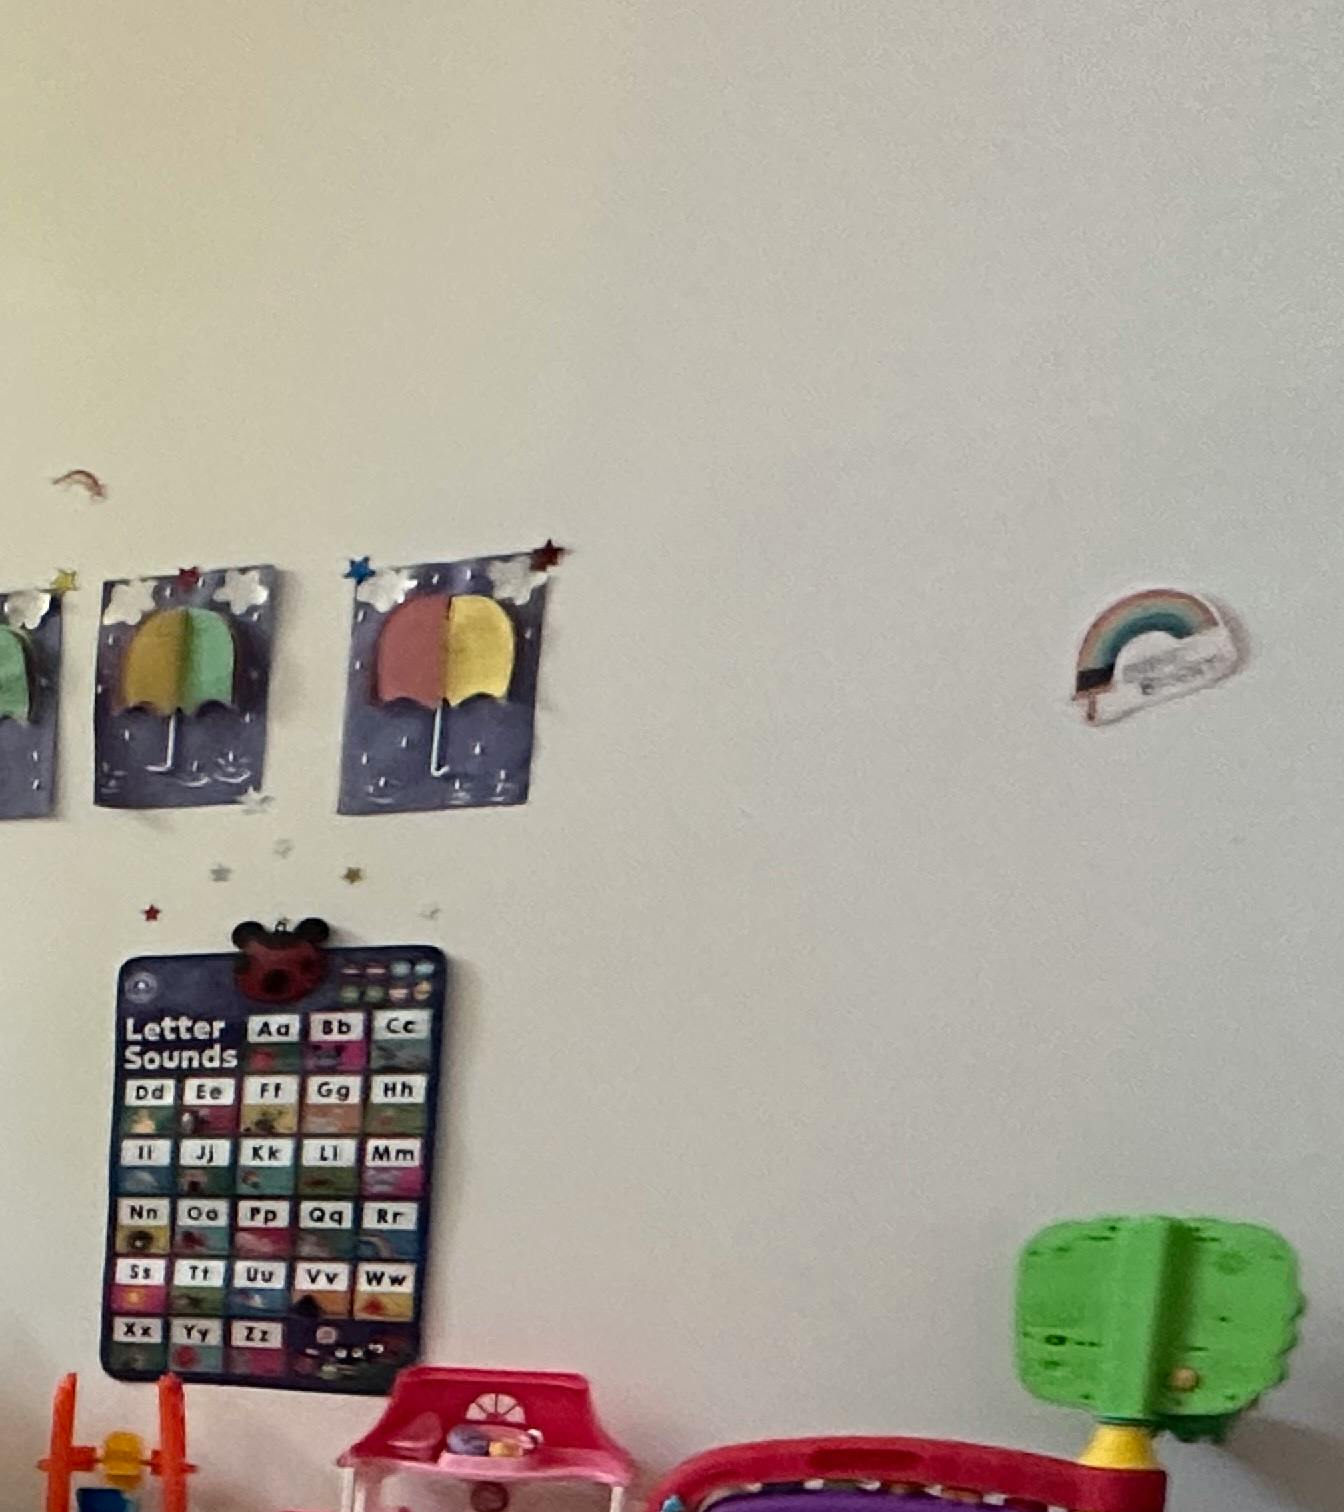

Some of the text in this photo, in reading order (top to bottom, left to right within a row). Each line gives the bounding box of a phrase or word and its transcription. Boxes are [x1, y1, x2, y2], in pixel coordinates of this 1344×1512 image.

[125, 1016, 226, 1042] Letter
[257, 1016, 417, 1037] Aa Bb Cc
[123, 1044, 238, 1071] Sounds
[135, 1081, 414, 1102] Dd Ee Ff Gg Hh
[194, 1146, 215, 1165] Jj
[251, 1145, 281, 1162] Kk
[319, 1145, 339, 1162] Ll
[371, 1144, 416, 1163] Mm
[130, 1205, 402, 1227] Nn Oo Pp Qq Rr
[129, 1264, 407, 1287] Ss Tt Uu Vv Ww
[123, 1322, 270, 1343] Xx Yy Zz
